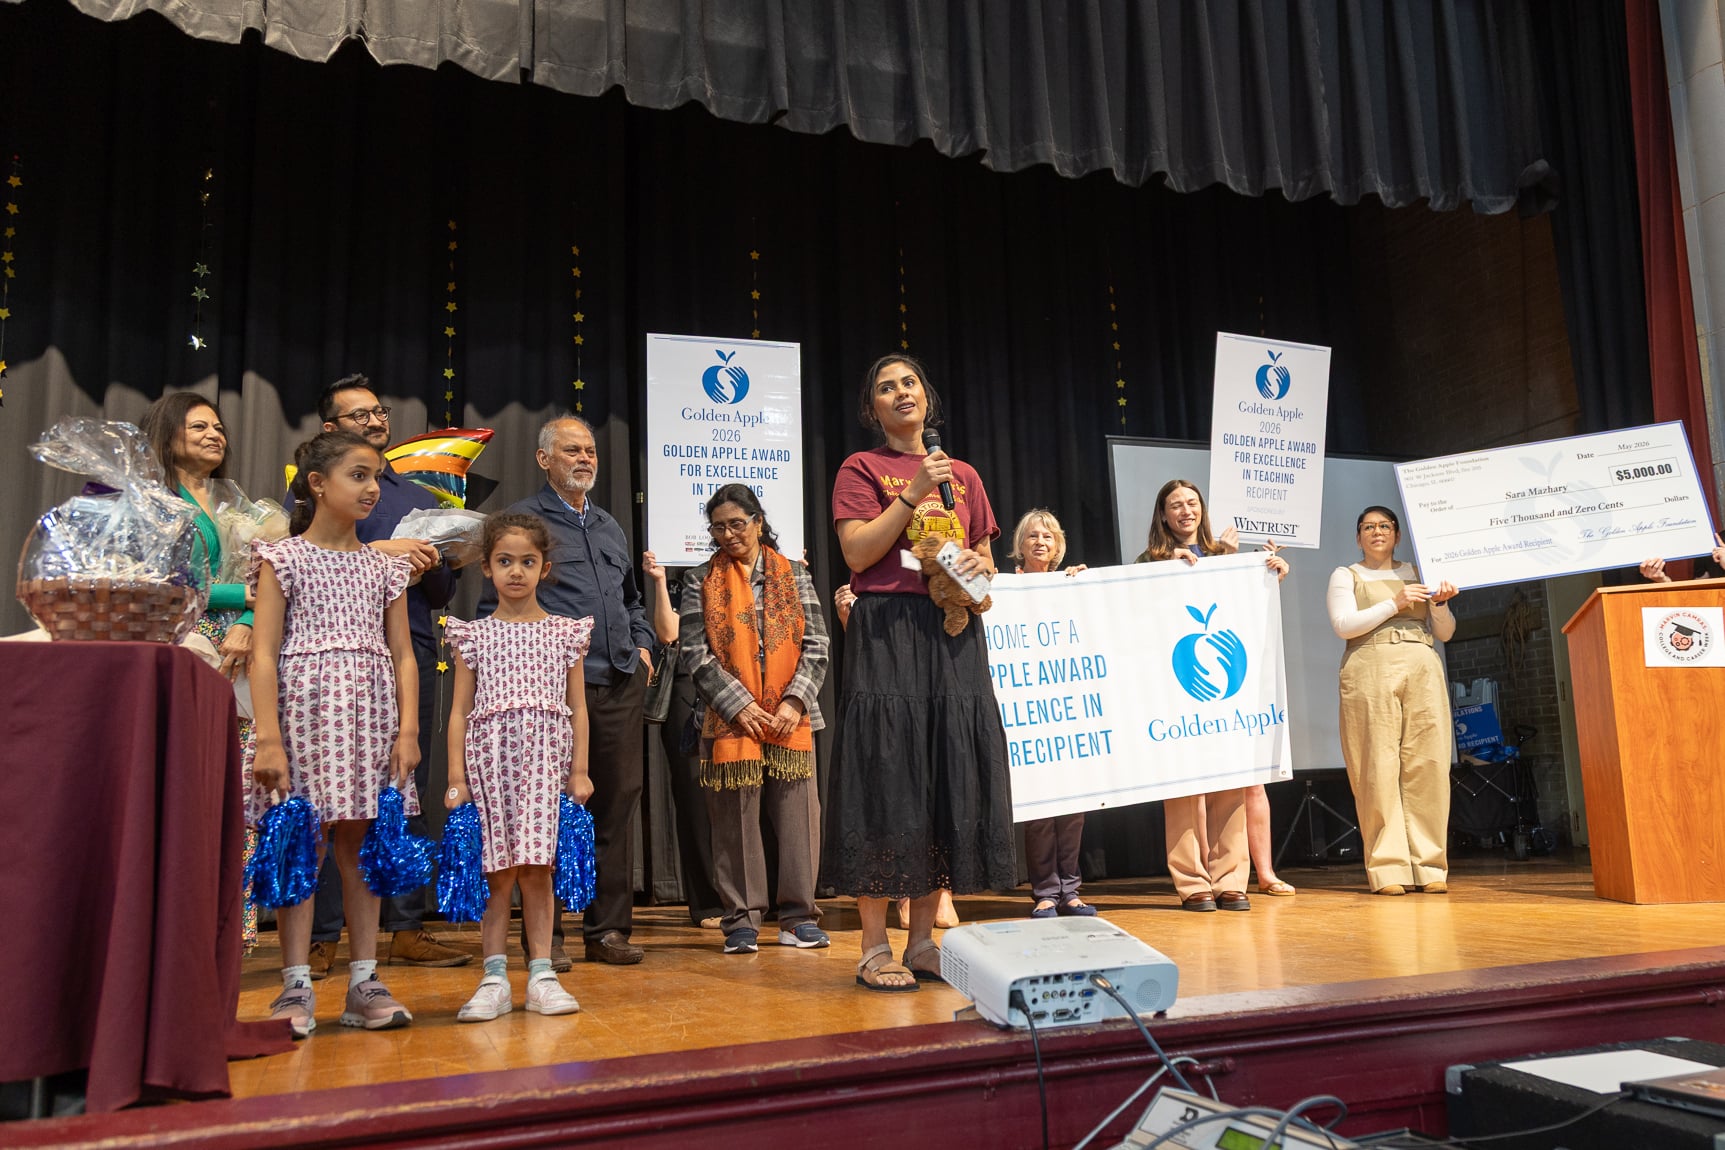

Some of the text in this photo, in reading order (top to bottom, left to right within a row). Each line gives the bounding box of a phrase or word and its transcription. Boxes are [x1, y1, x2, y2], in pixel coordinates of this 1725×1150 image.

[681, 406, 730, 422] Golden
[1238, 400, 1304, 422] Golden Apple
[712, 428, 741, 443] 2026
[1259, 421, 1281, 435] 2026
[663, 444, 791, 462] GOLDEN APPLE AWARD
[1223, 433, 1317, 454] GOLDEN APPLE AWARD
[1576, 452, 1595, 460] Date
[1634, 440, 1650, 449] 2026
[1234, 451, 1307, 470] FOR EXCELLENCE
[680, 463, 779, 480] FOR EXCELLENCE
[1242, 469, 1295, 485] IN TEACHING
[1615, 463, 1673, 482] $5,000.00
[692, 483, 764, 498] IN TENG
[1246, 486, 1288, 502] RECIPIENT
[1505, 484, 1568, 500] Sara Mazhary
[1489, 495, 1690, 527] Five Thousand and Zero Cents Dollars
[918, 530, 958, 540] SM
[1037, 621, 1061, 647] OF
[1069, 619, 1080, 644] A
[1659, 632, 1672, 655] COLLEGE
[1686, 648, 1706, 661] CAREER
[1038, 654, 1108, 686] AWARD
[1001, 692, 1103, 728] LLENCE IN
[1148, 713, 1229, 742] Golden
[1009, 729, 1113, 767] RECIPIENT
